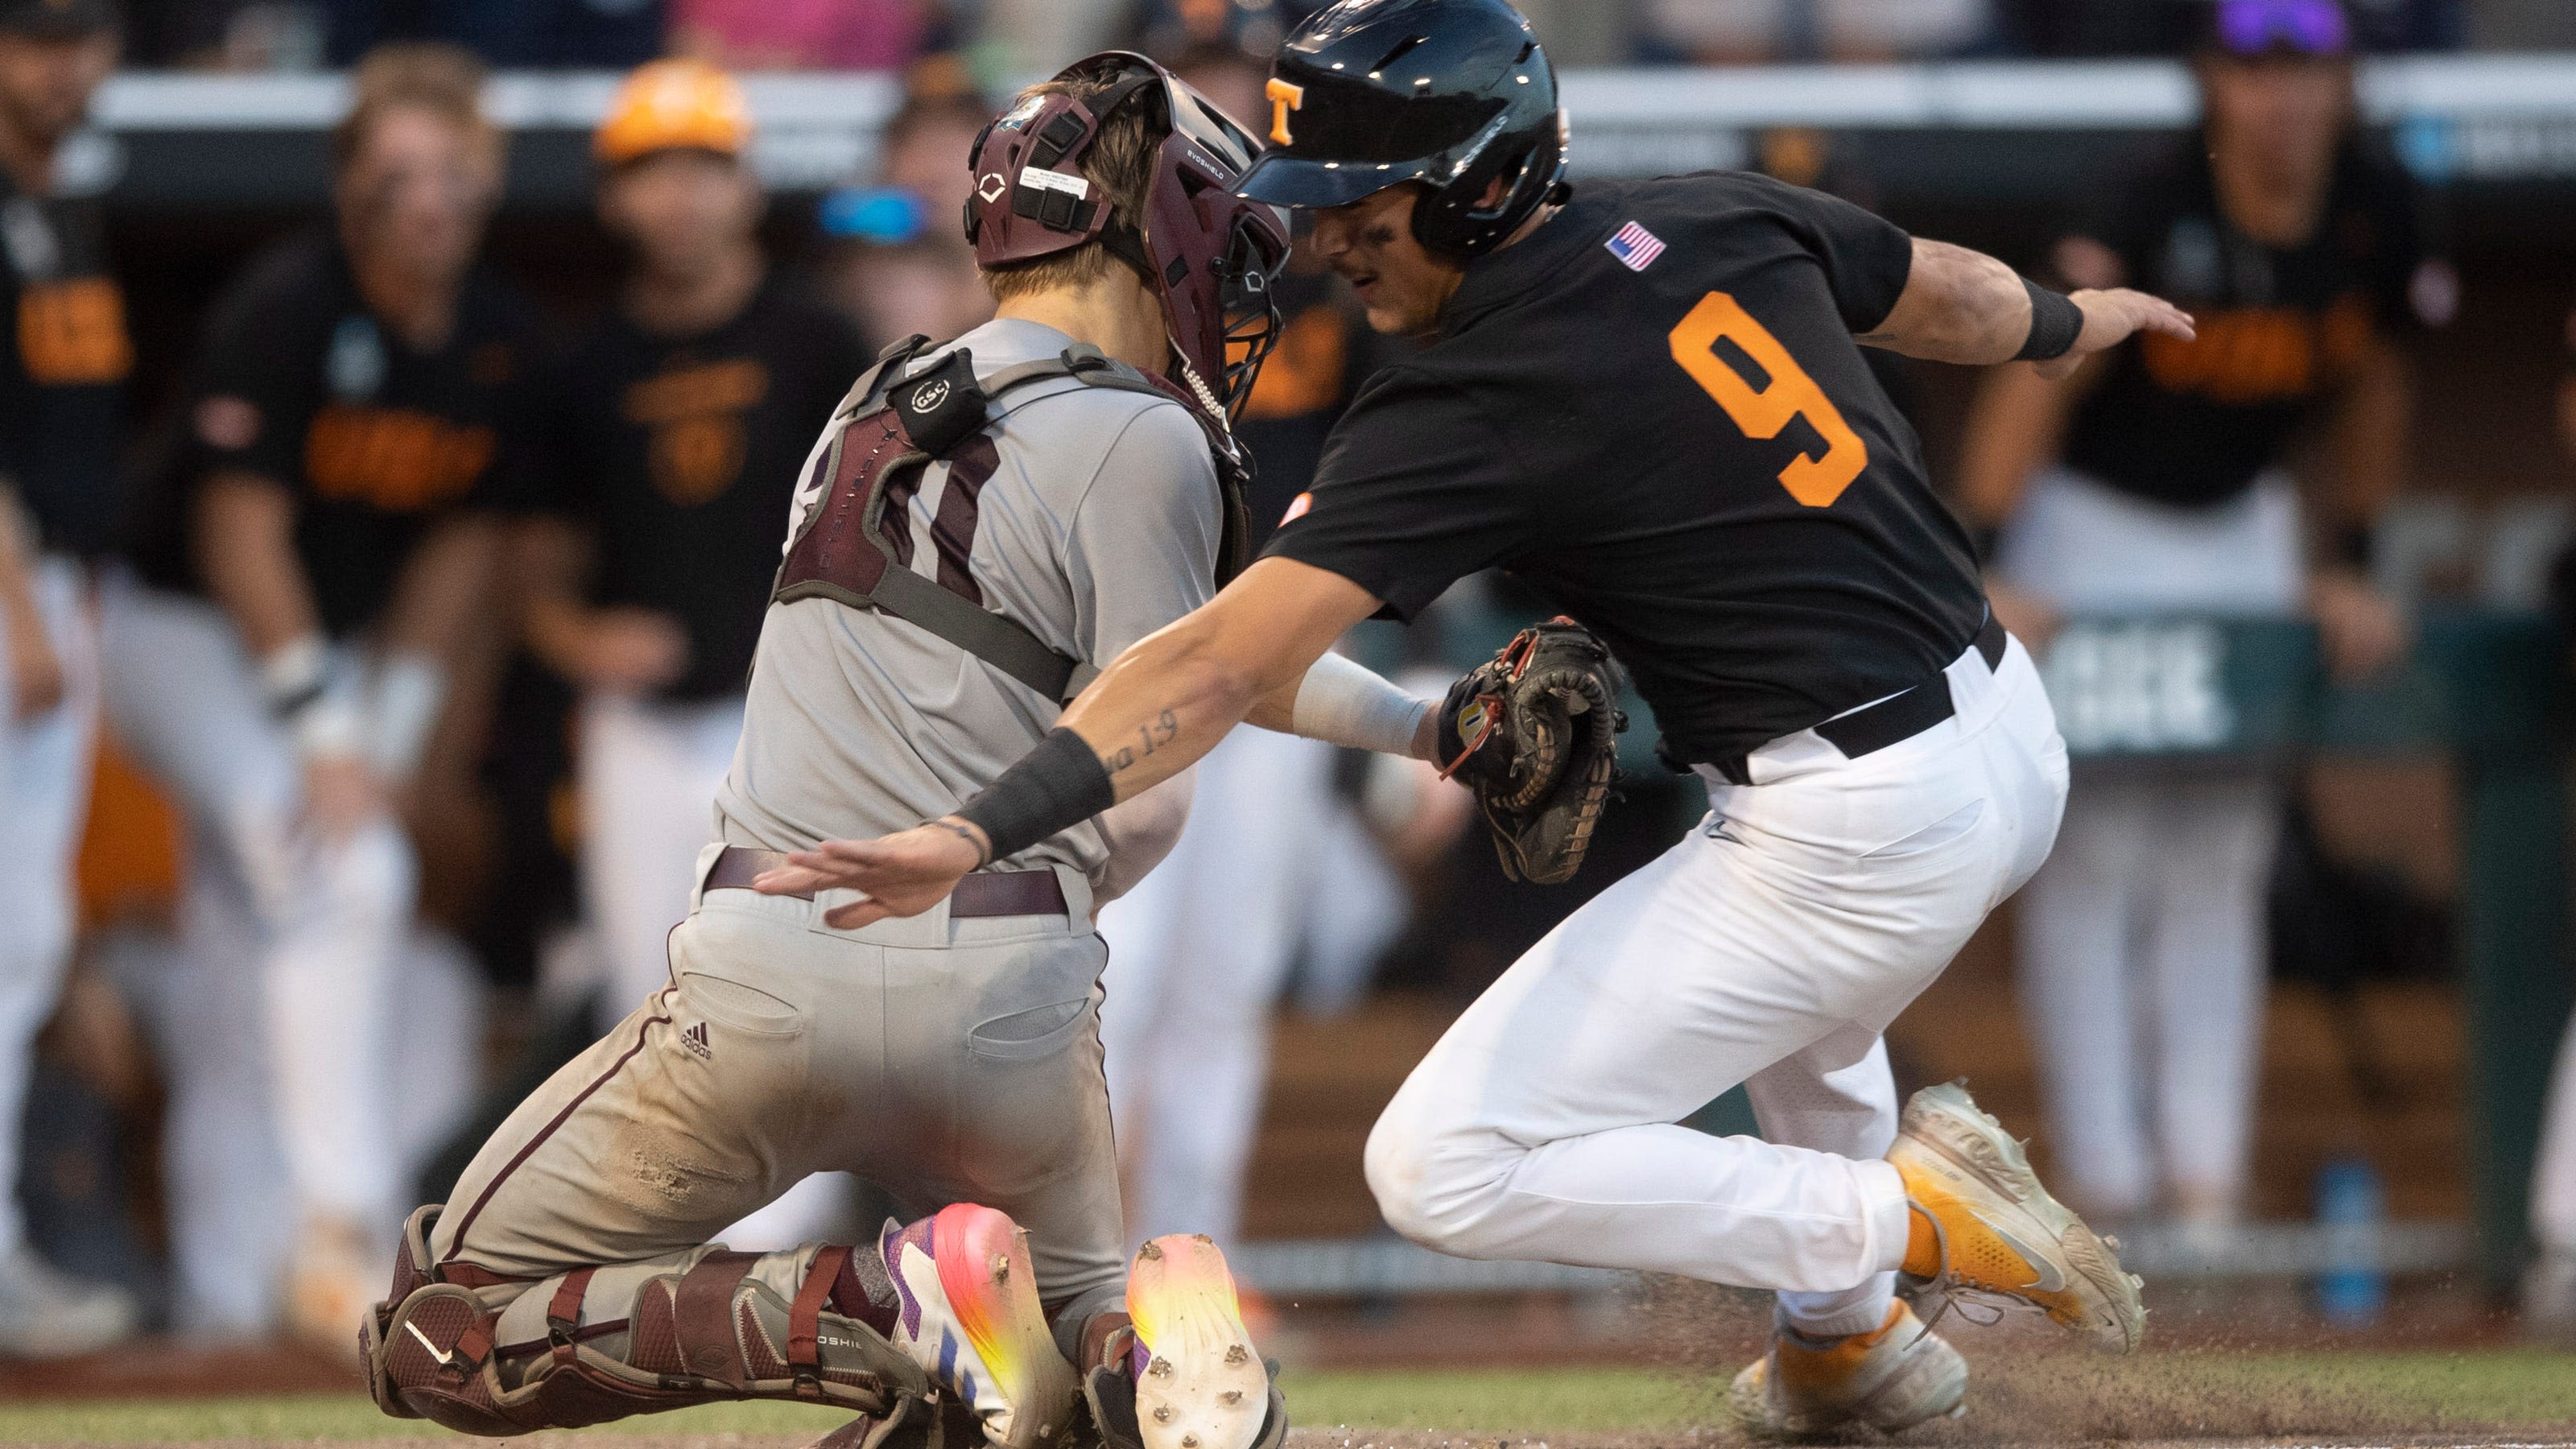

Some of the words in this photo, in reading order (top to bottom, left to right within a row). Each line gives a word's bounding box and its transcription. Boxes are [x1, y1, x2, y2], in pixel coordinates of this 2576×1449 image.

[1265, 76, 1304, 147] T
[1187, 149, 1224, 180] EVOSHIELD
[916, 382, 945, 408] GSC
[1667, 290, 1868, 508] 9
[1139, 708, 1178, 756] 1:9
[680, 1034, 712, 1060] adidas
